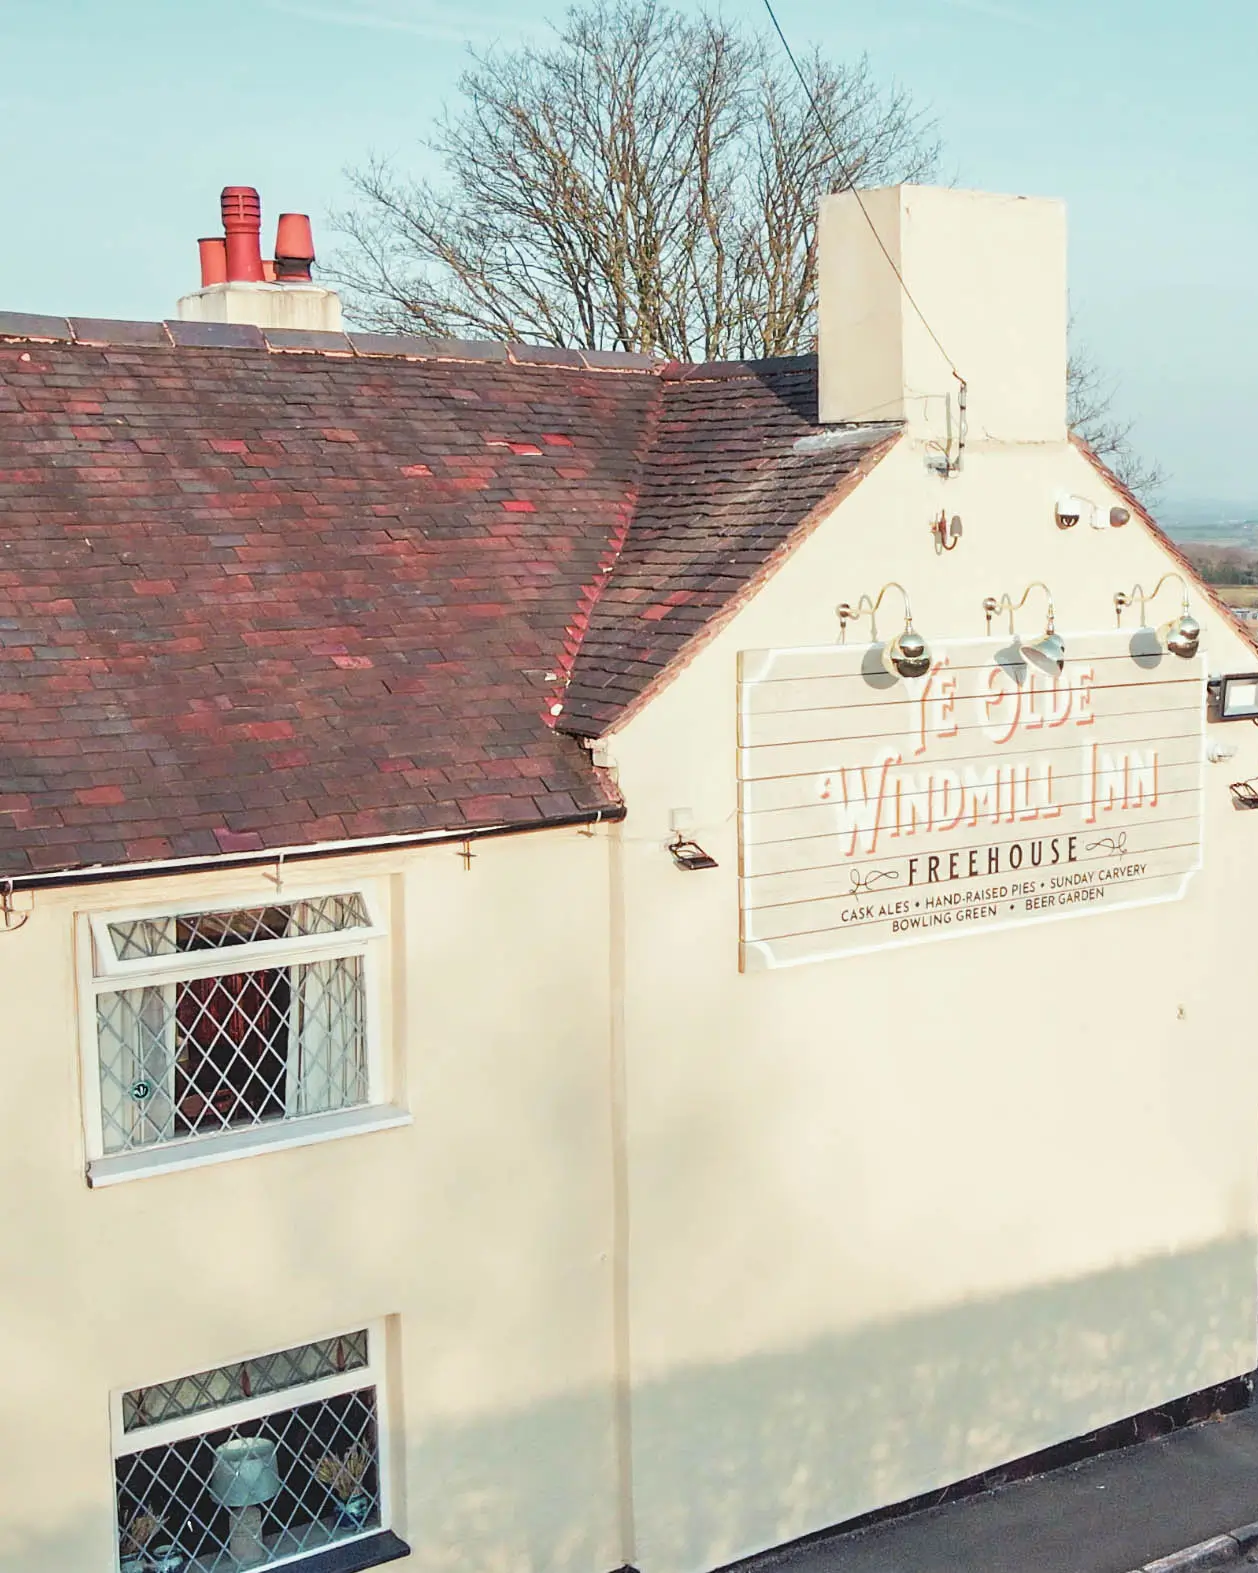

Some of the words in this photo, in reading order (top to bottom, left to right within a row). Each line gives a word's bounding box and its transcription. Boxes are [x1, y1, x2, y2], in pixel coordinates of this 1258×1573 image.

[902, 651, 958, 756] YE
[977, 656, 1095, 745] OLDE
[815, 746, 1062, 856] WINDMILL
[1082, 737, 1158, 823] INN
[908, 836, 1078, 886] FREEHOUSE
[841, 905, 874, 923] CASK
[878, 900, 910, 917] ALES
[926, 887, 1008, 909] HAND-RAISED
[1011, 881, 1036, 897] PIES
[1050, 871, 1095, 889] SUNDAY
[1098, 863, 1148, 882] CARVERY
[892, 912, 952, 933] BOWLING
[956, 905, 997, 923] GREEN
[1025, 895, 1056, 911] BEER
[1058, 887, 1105, 905] GARDEN
